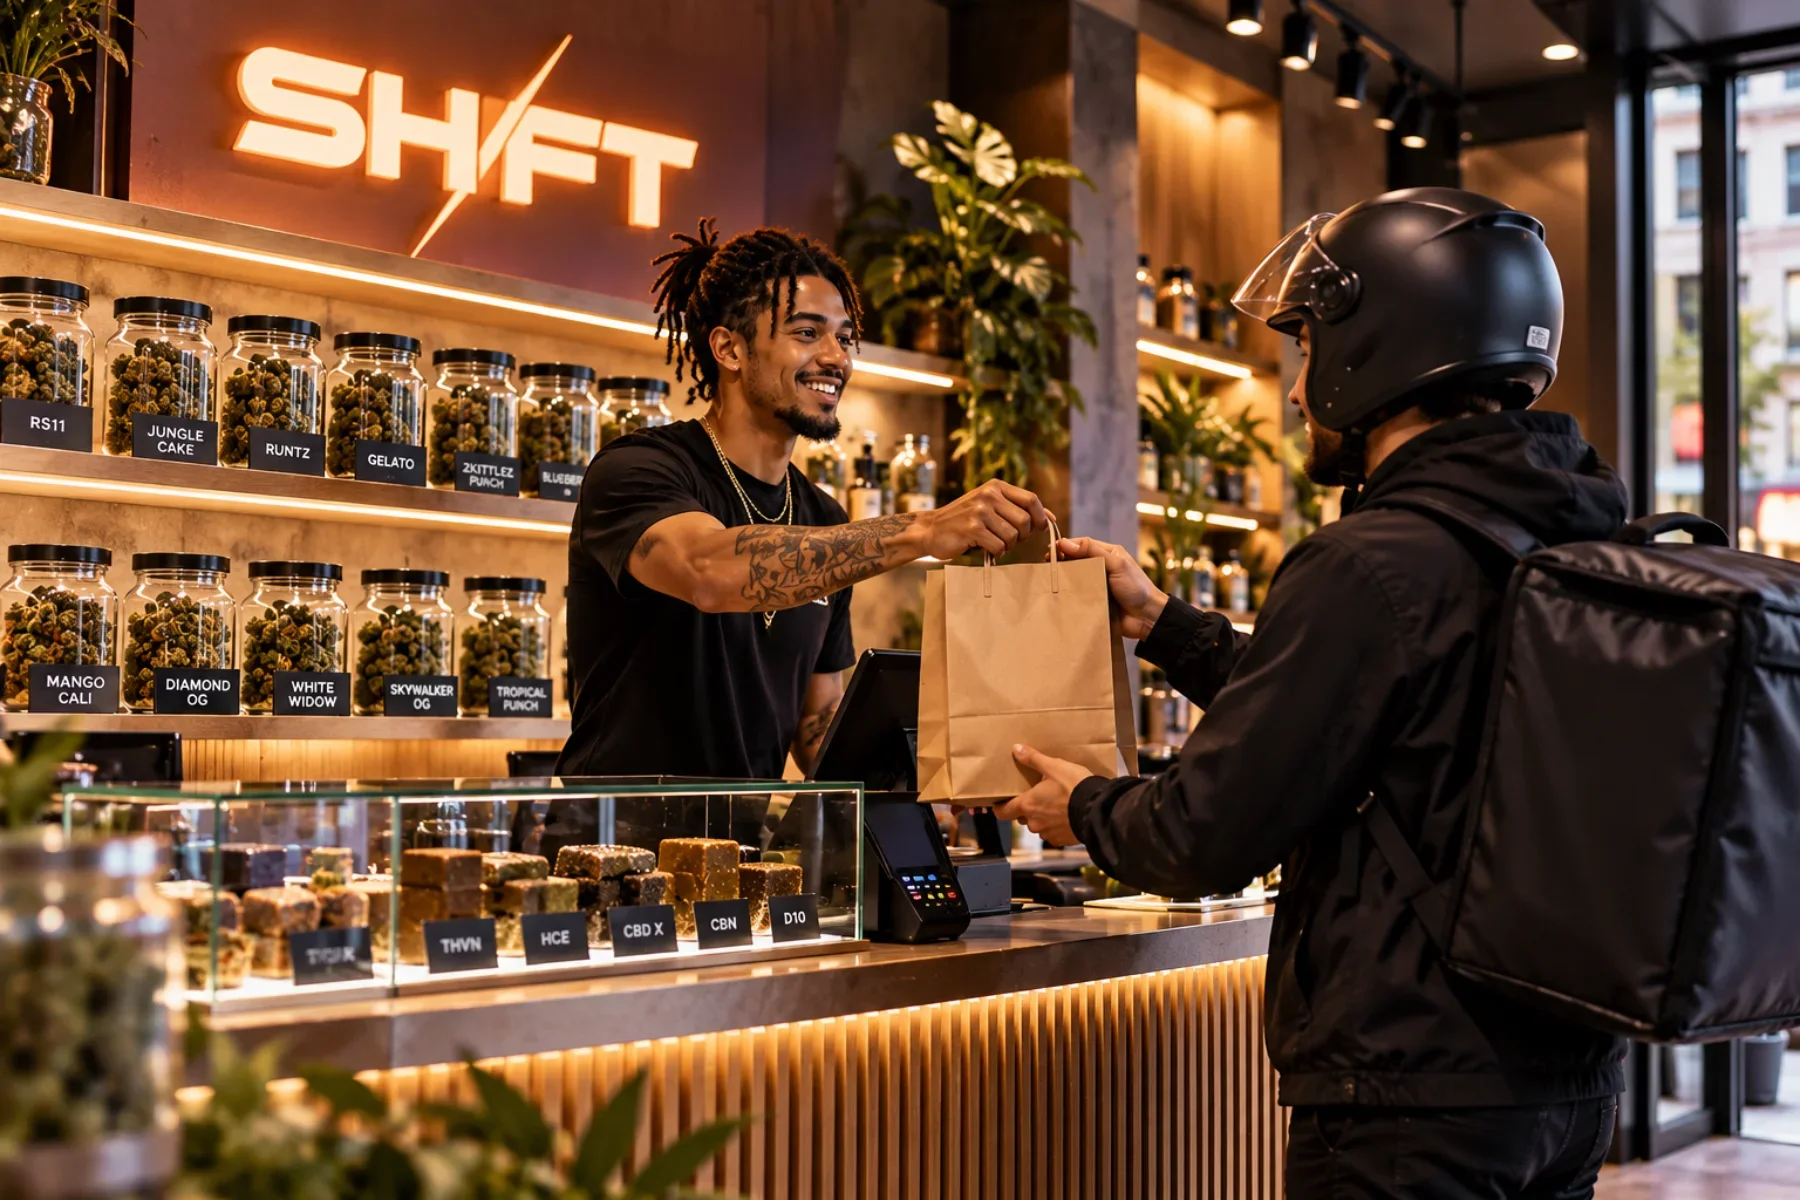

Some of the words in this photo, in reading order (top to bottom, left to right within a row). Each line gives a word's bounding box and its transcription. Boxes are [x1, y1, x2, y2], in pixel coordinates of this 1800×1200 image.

[31, 416, 64, 432] RS11
[148, 425, 203, 441] JUNGLE
[158, 441, 194, 455] CAKE
[266, 443, 310, 458] RUNTZ
[368, 454, 414, 469] GELATO
[47, 675, 105, 688] MANGO
[166, 679, 230, 691] DIAMOND
[292, 681, 334, 693] WHITE
[391, 684, 453, 696] SKYWALKER
[497, 686, 547, 698] TROPICAL
[59, 692, 91, 704] CALI
[187, 694, 208, 705] OG
[289, 696, 337, 707] WIDOW
[414, 698, 430, 709] OG
[504, 700, 538, 711] PUNCH
[711, 917, 736, 930] CBN
[784, 911, 805, 924] D10
[624, 924, 651, 938] CBD
[655, 922, 663, 935] X
[541, 930, 570, 945] HCE
